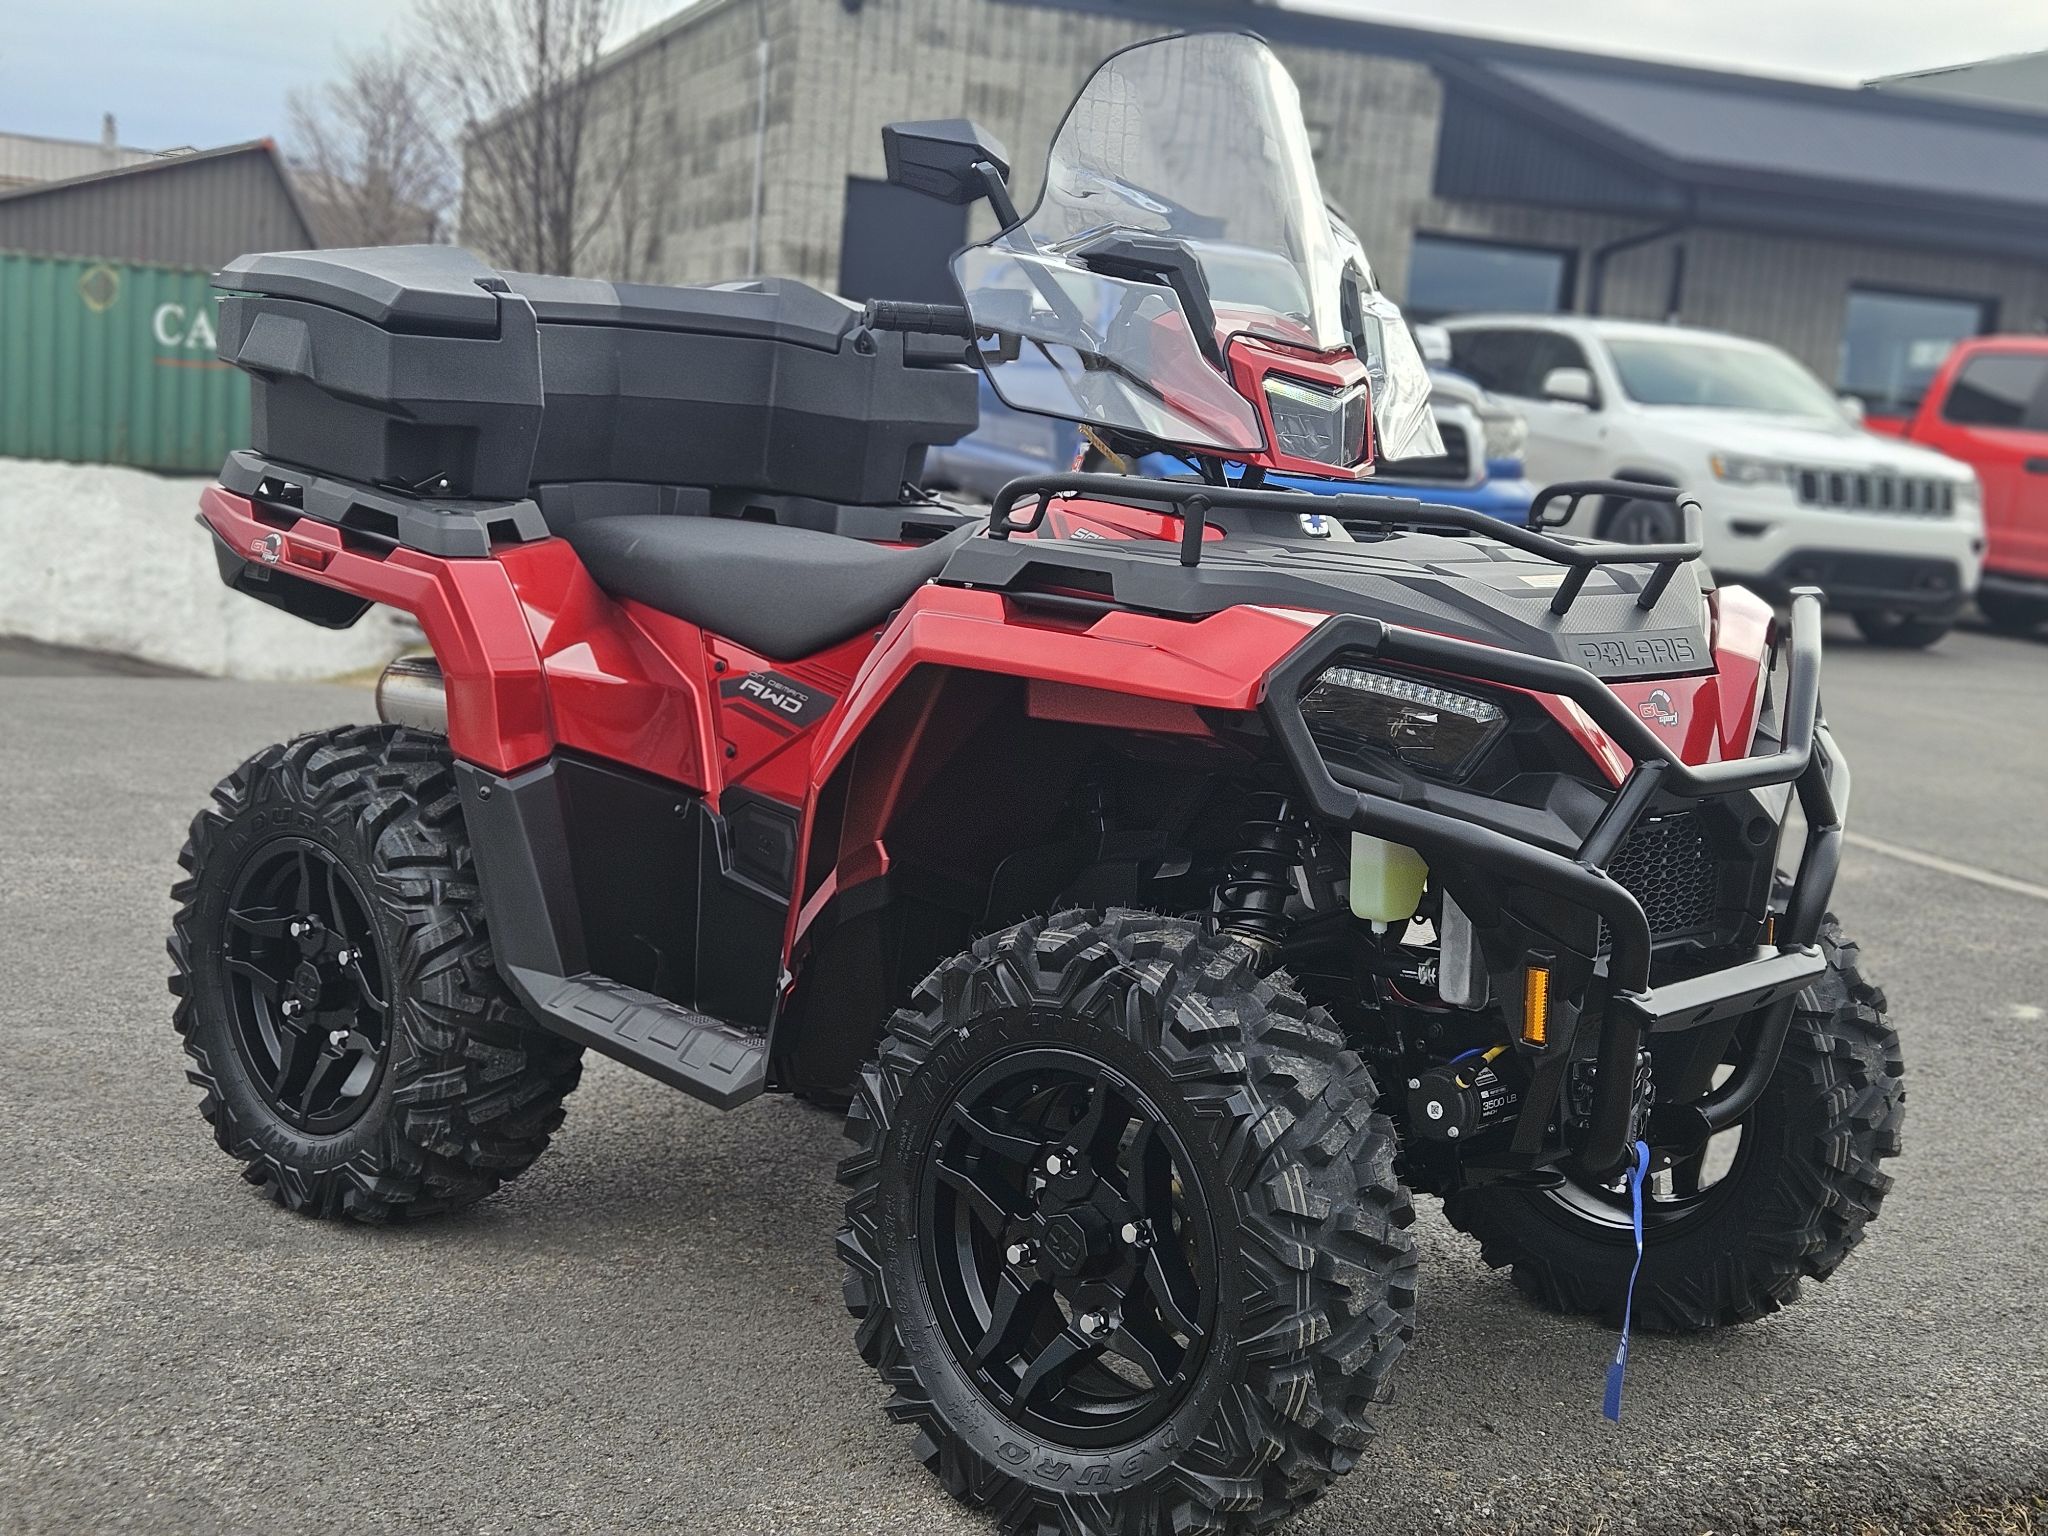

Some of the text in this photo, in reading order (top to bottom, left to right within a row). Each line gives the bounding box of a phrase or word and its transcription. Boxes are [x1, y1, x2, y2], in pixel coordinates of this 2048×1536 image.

[1578, 637, 1695, 668] POLARIS
[739, 678, 803, 714] AWD
[250, 808, 340, 846] DURO
[1482, 1097, 1505, 1111] 3500
[995, 1438, 1153, 1486] DURO
